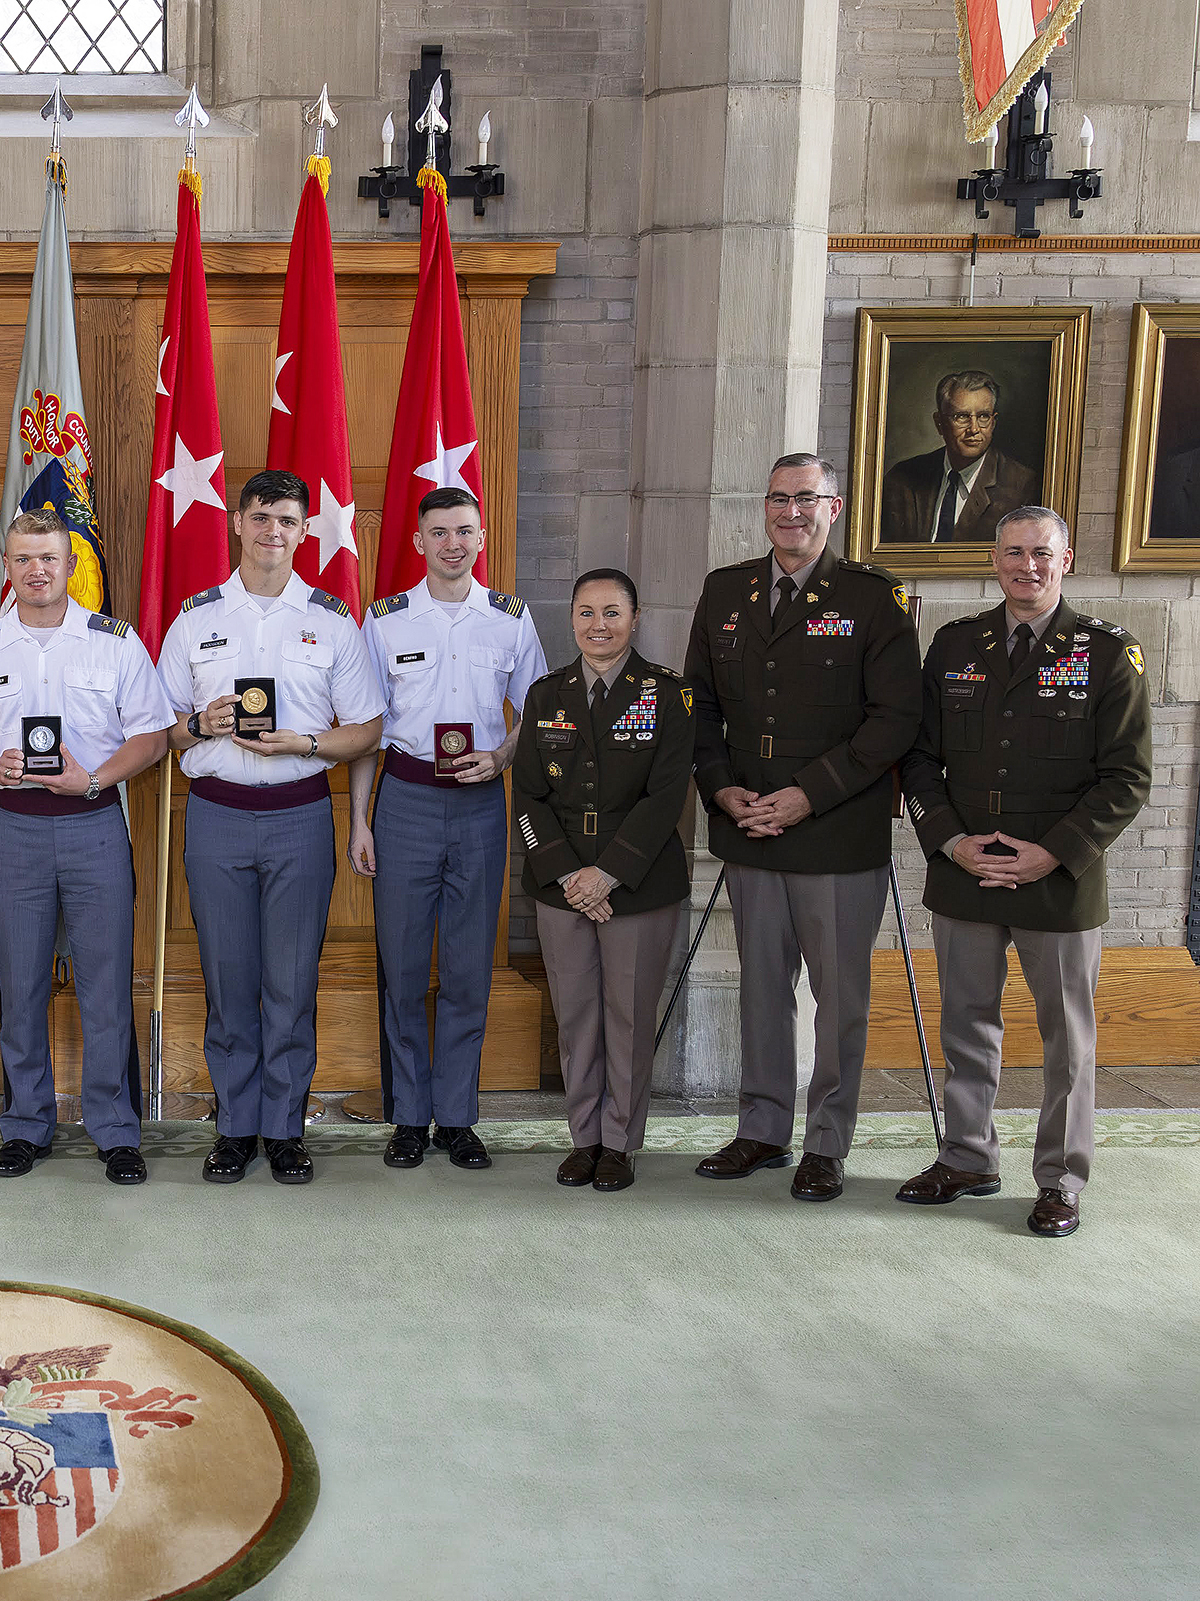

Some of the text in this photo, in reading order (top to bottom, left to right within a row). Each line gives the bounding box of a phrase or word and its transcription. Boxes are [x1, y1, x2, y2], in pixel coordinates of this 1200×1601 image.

[24, 414, 42, 446] DUTY
[45, 400, 60, 449] HONOR
[69, 419, 93, 467] COUN
